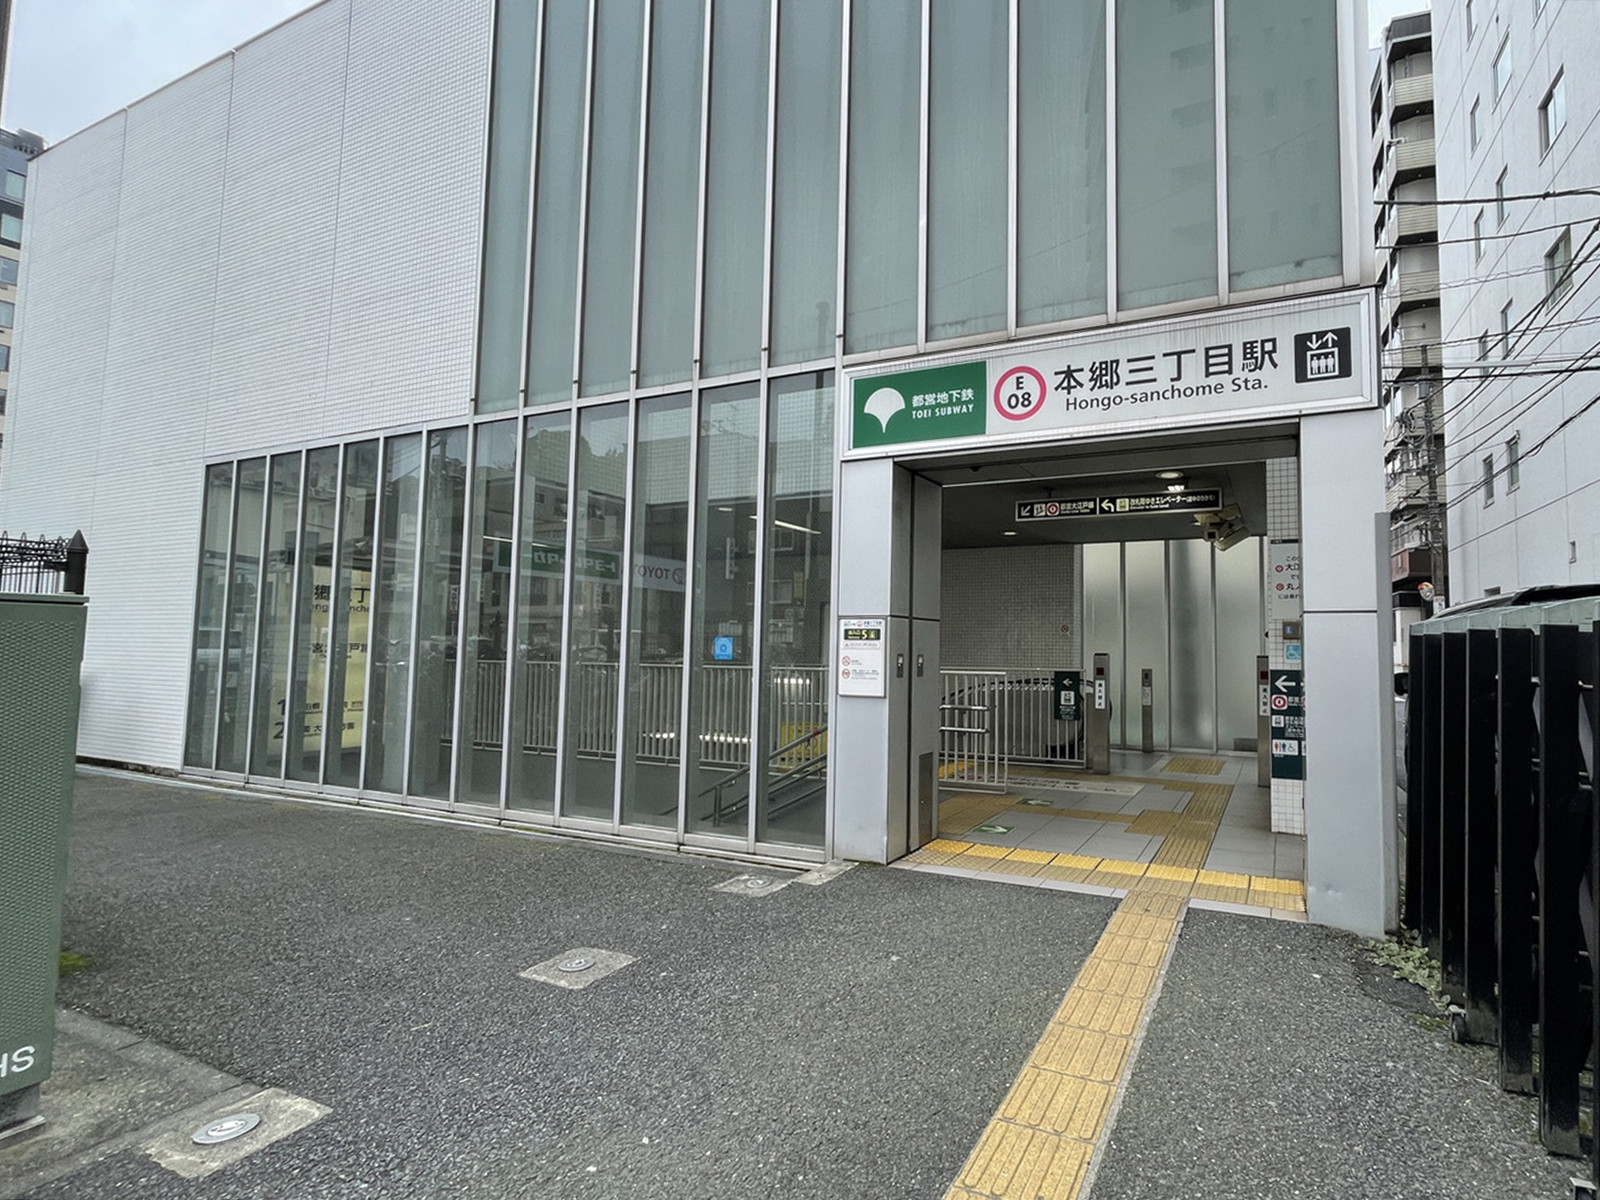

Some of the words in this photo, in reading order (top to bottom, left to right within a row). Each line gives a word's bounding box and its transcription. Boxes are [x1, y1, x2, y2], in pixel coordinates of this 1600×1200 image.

[1053, 337, 1279, 396] 本郷三丁目駅
[1015, 377, 1025, 391] E
[912, 388, 974, 408] 都営地下鉄
[1007, 391, 1033, 410] 08
[1065, 380, 1225, 412] Hongo-sanchome
[1231, 376, 1269, 392] Sta.
[911, 409, 931, 419] TOEI
[935, 404, 974, 417] SUBWAY
[861, 629, 868, 640] 5
